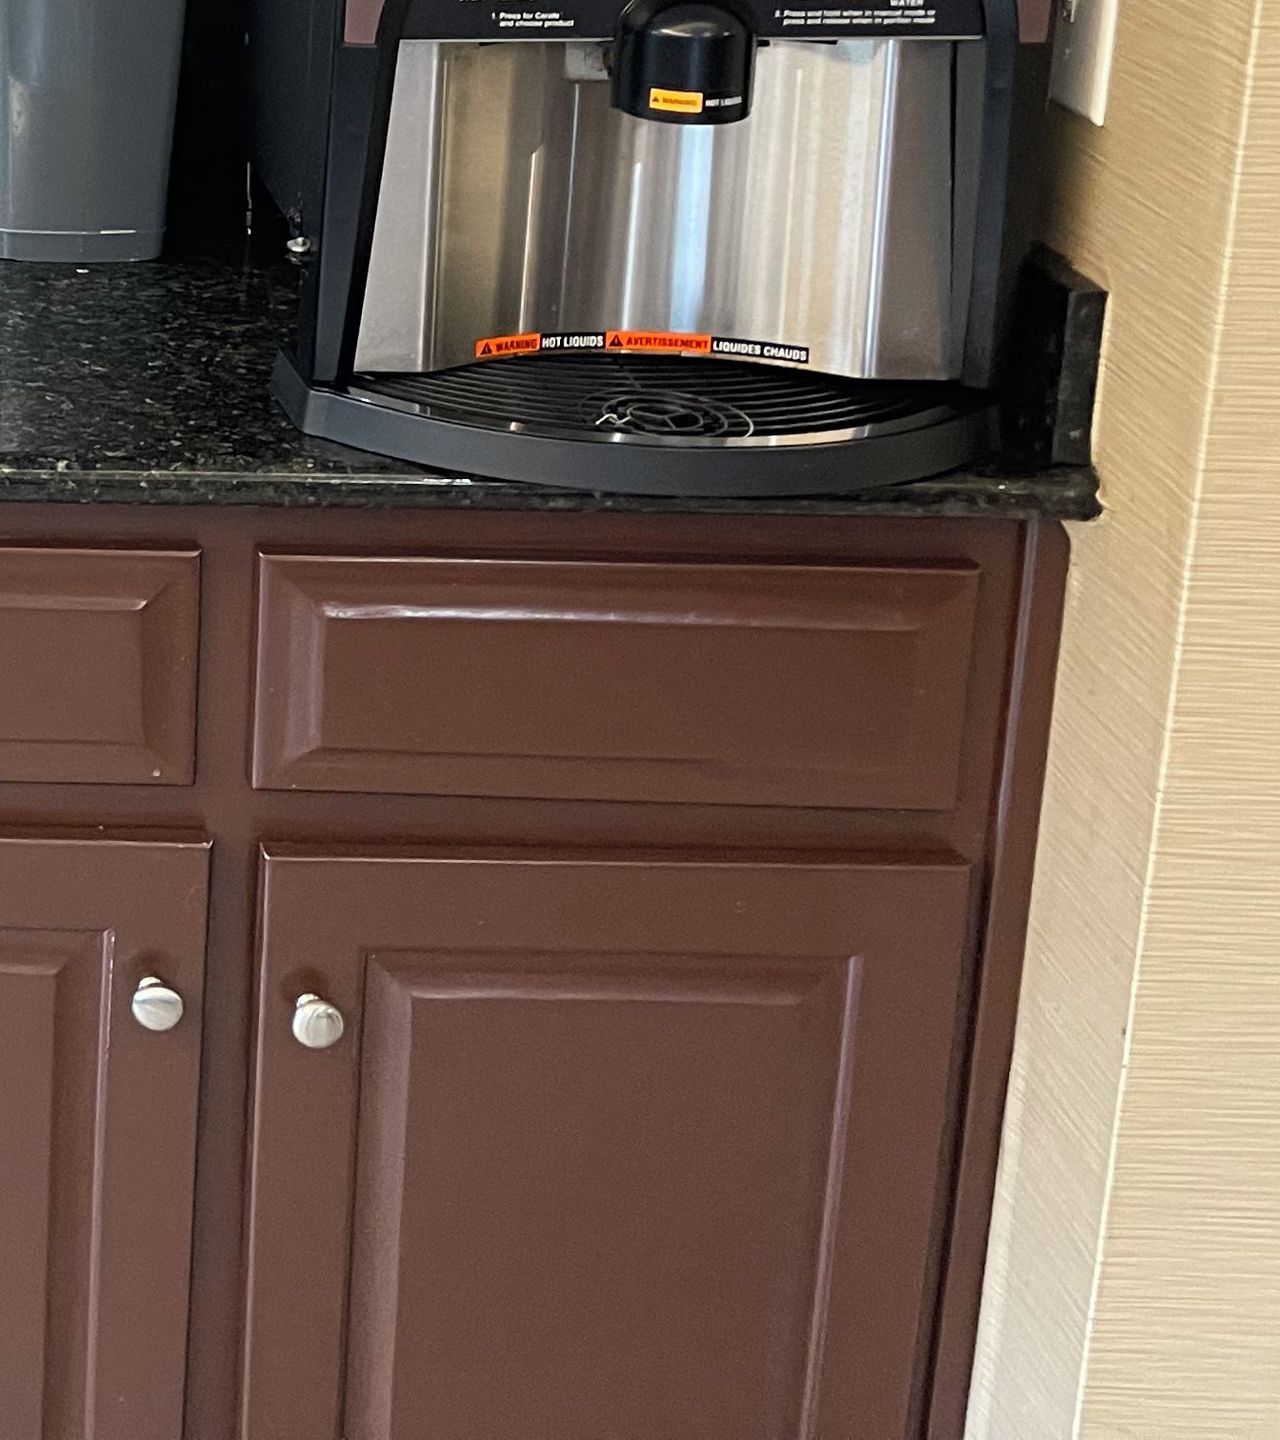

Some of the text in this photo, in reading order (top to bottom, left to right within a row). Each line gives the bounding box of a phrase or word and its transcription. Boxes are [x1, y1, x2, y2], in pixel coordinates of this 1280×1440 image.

[495, 335, 807, 361] WARNING HOT LIQUIDS AVERTISSEMENT LIQUIDES CHAUDS
